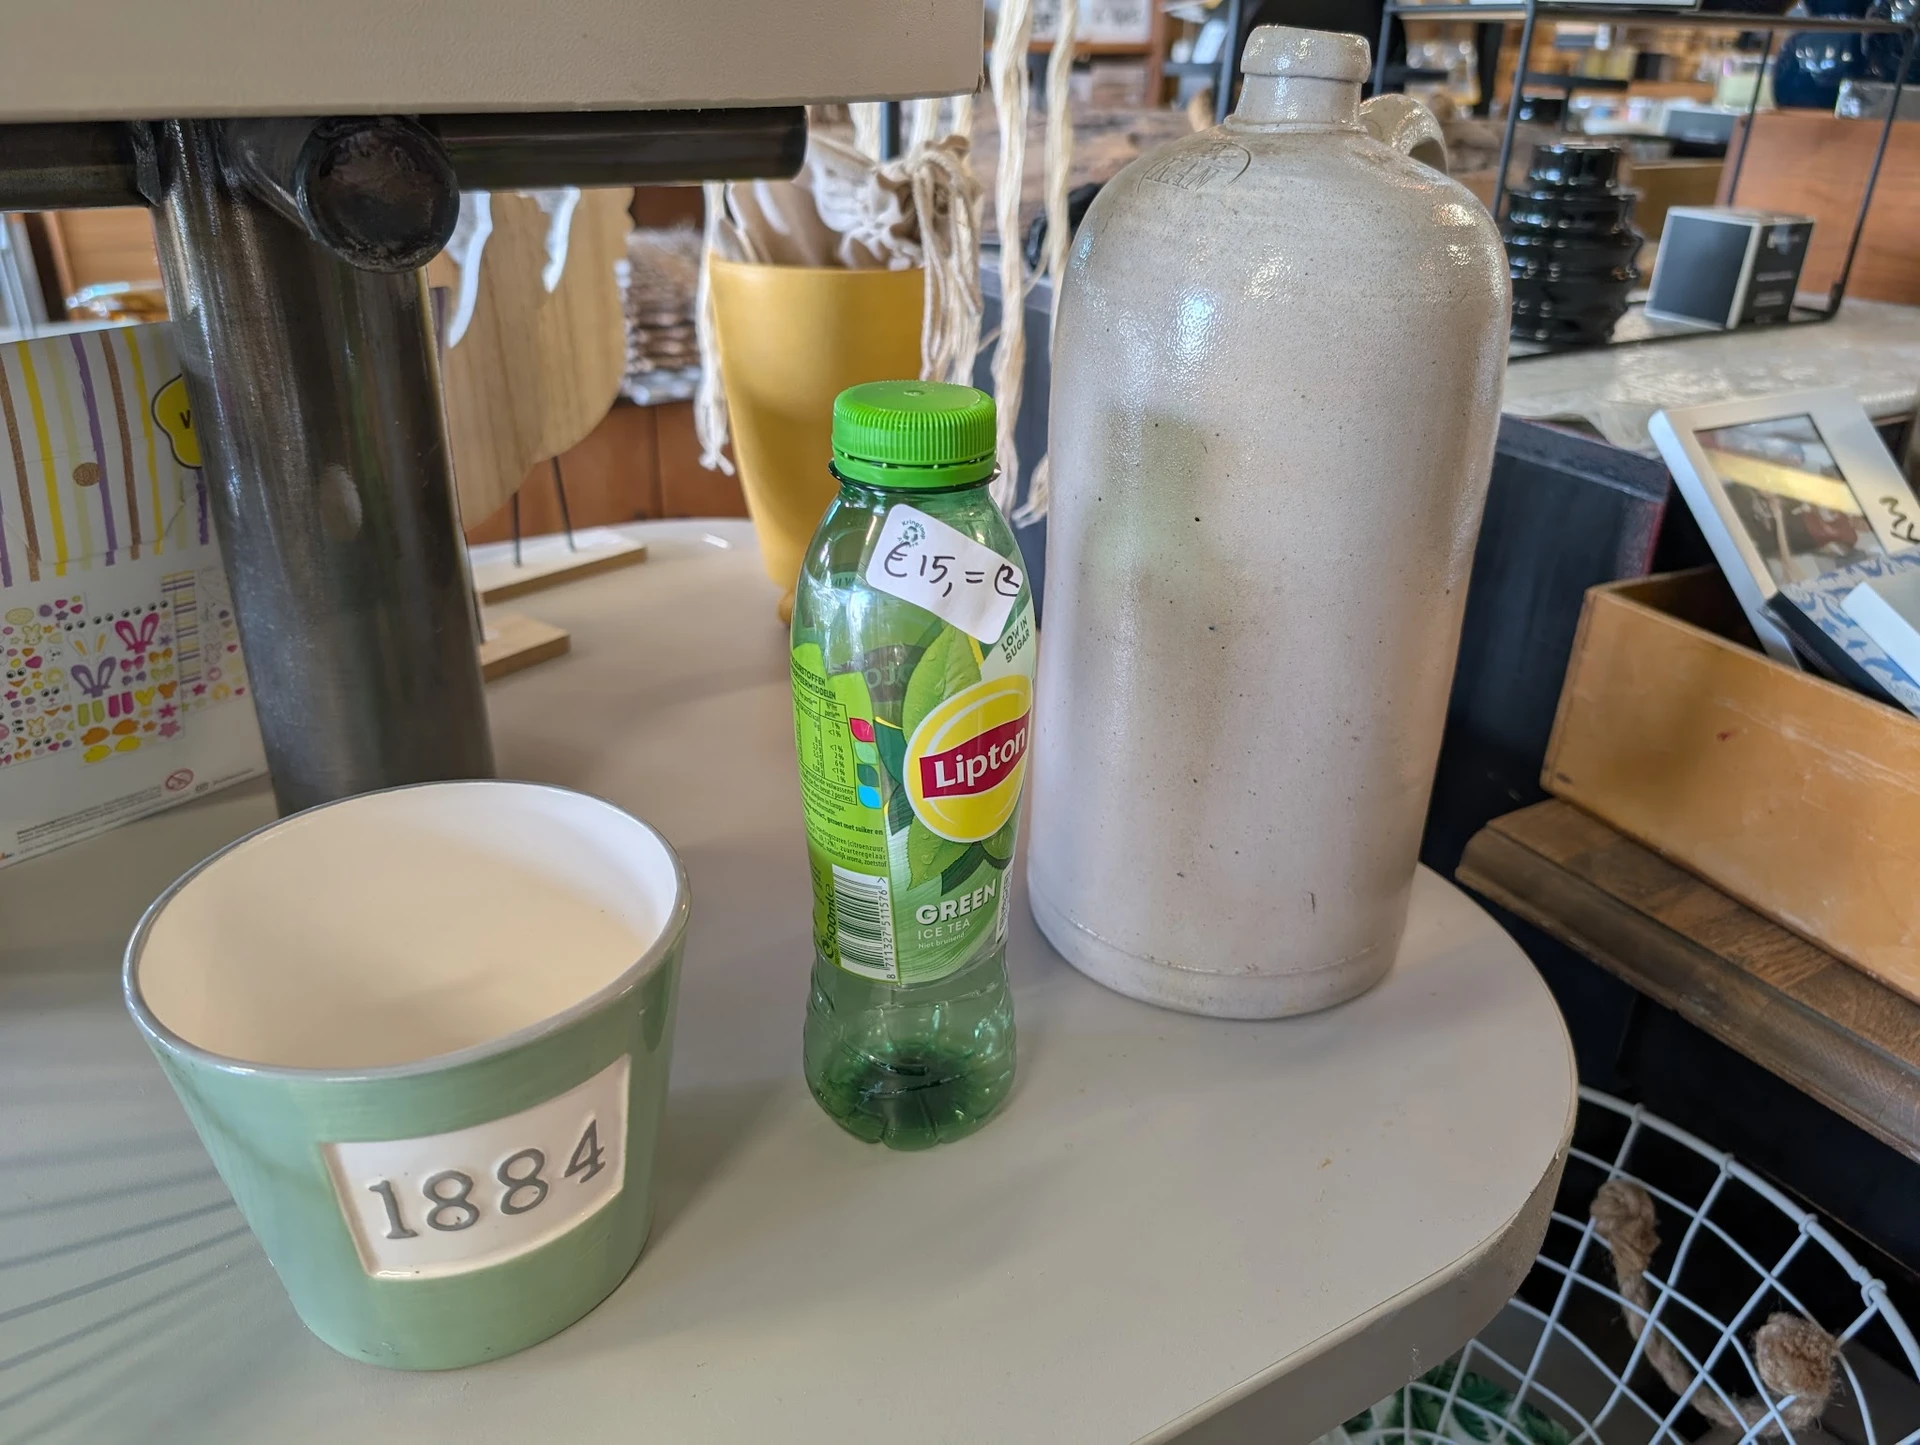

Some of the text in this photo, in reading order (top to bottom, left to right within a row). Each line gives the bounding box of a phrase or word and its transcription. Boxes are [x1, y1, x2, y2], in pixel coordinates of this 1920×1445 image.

[1001, 616, 1028, 653] LOW IN
[1005, 628, 1031, 664] SUGAR
[934, 727, 1026, 788] Lipton
[916, 878, 997, 925] GREEN
[917, 918, 970, 940] ICE TEA
[918, 931, 965, 949] Niet bruisend
[368, 1119, 606, 1240] 1884
